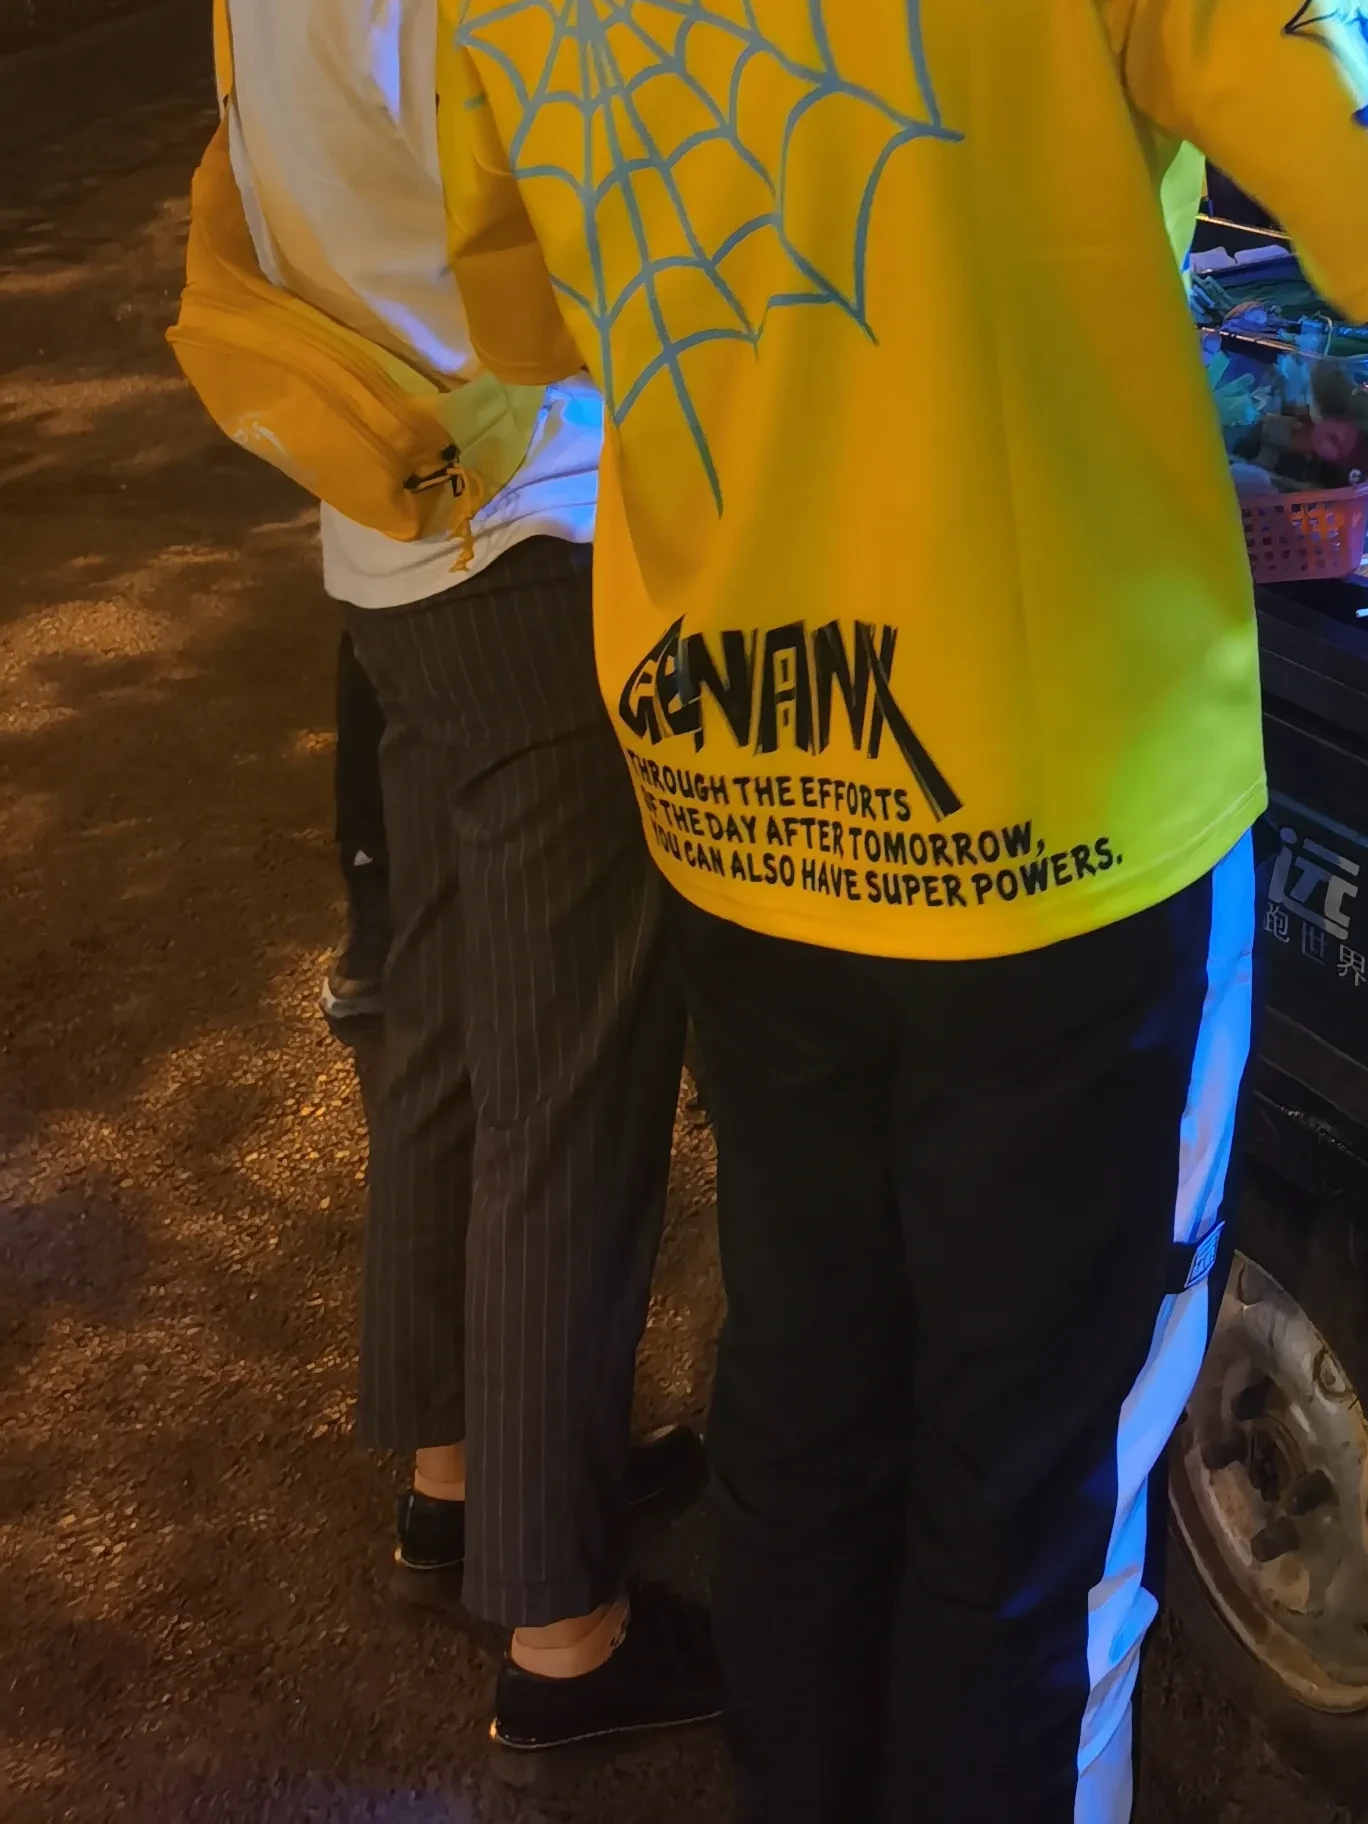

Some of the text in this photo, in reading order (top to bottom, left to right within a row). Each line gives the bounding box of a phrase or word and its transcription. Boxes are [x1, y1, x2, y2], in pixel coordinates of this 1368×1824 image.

[627, 749, 911, 823] THROUGH THE EFFORTS
[659, 799, 706, 837] THE
[704, 811, 757, 845] DAY
[766, 816, 845, 859] AFTER
[848, 818, 1046, 867] TOMORROW,
[683, 839, 725, 879] CAN
[730, 850, 796, 888] ALSO
[801, 857, 862, 901] HAVE
[864, 869, 968, 907] SUPER
[971, 836, 1124, 906] POWERS.
